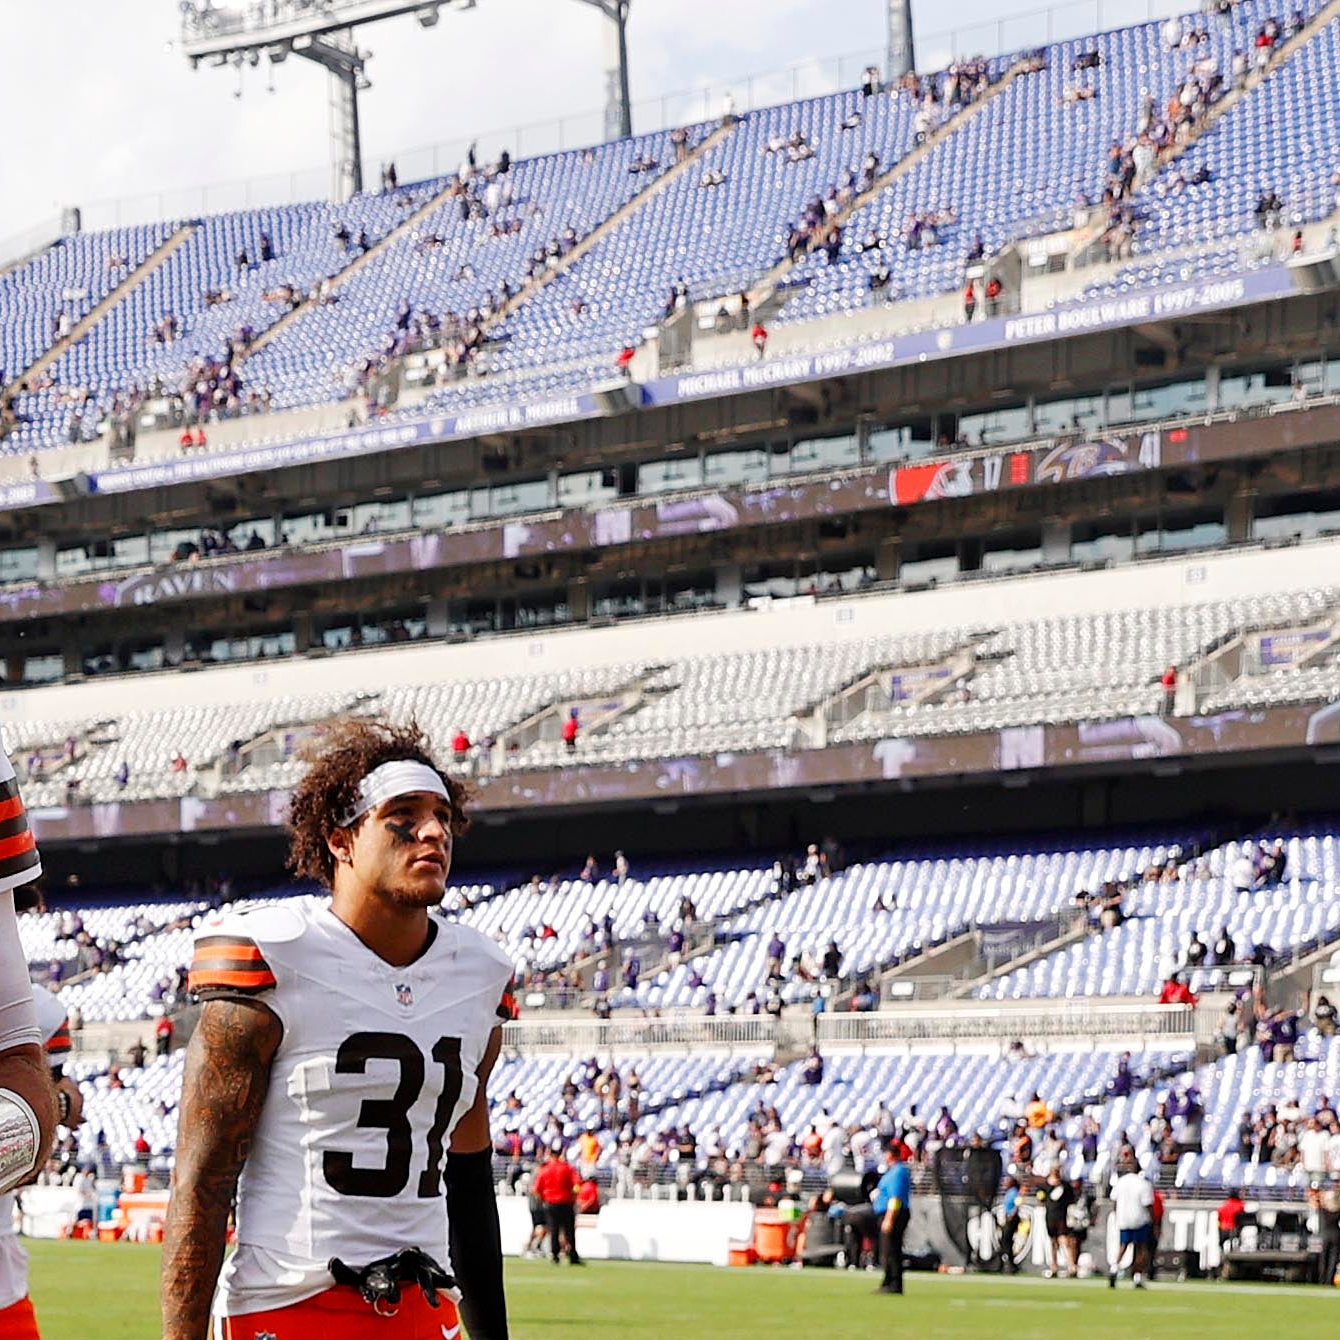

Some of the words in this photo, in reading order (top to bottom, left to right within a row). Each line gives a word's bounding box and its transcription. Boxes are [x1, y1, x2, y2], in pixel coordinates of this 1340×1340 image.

[1005, 313, 1056, 340] PETER
[1058, 295, 1150, 331] BOULWARE
[677, 369, 741, 397] MICHAEL
[814, 341, 895, 375] 1997-2002
[323, 1031, 463, 1198] 31
